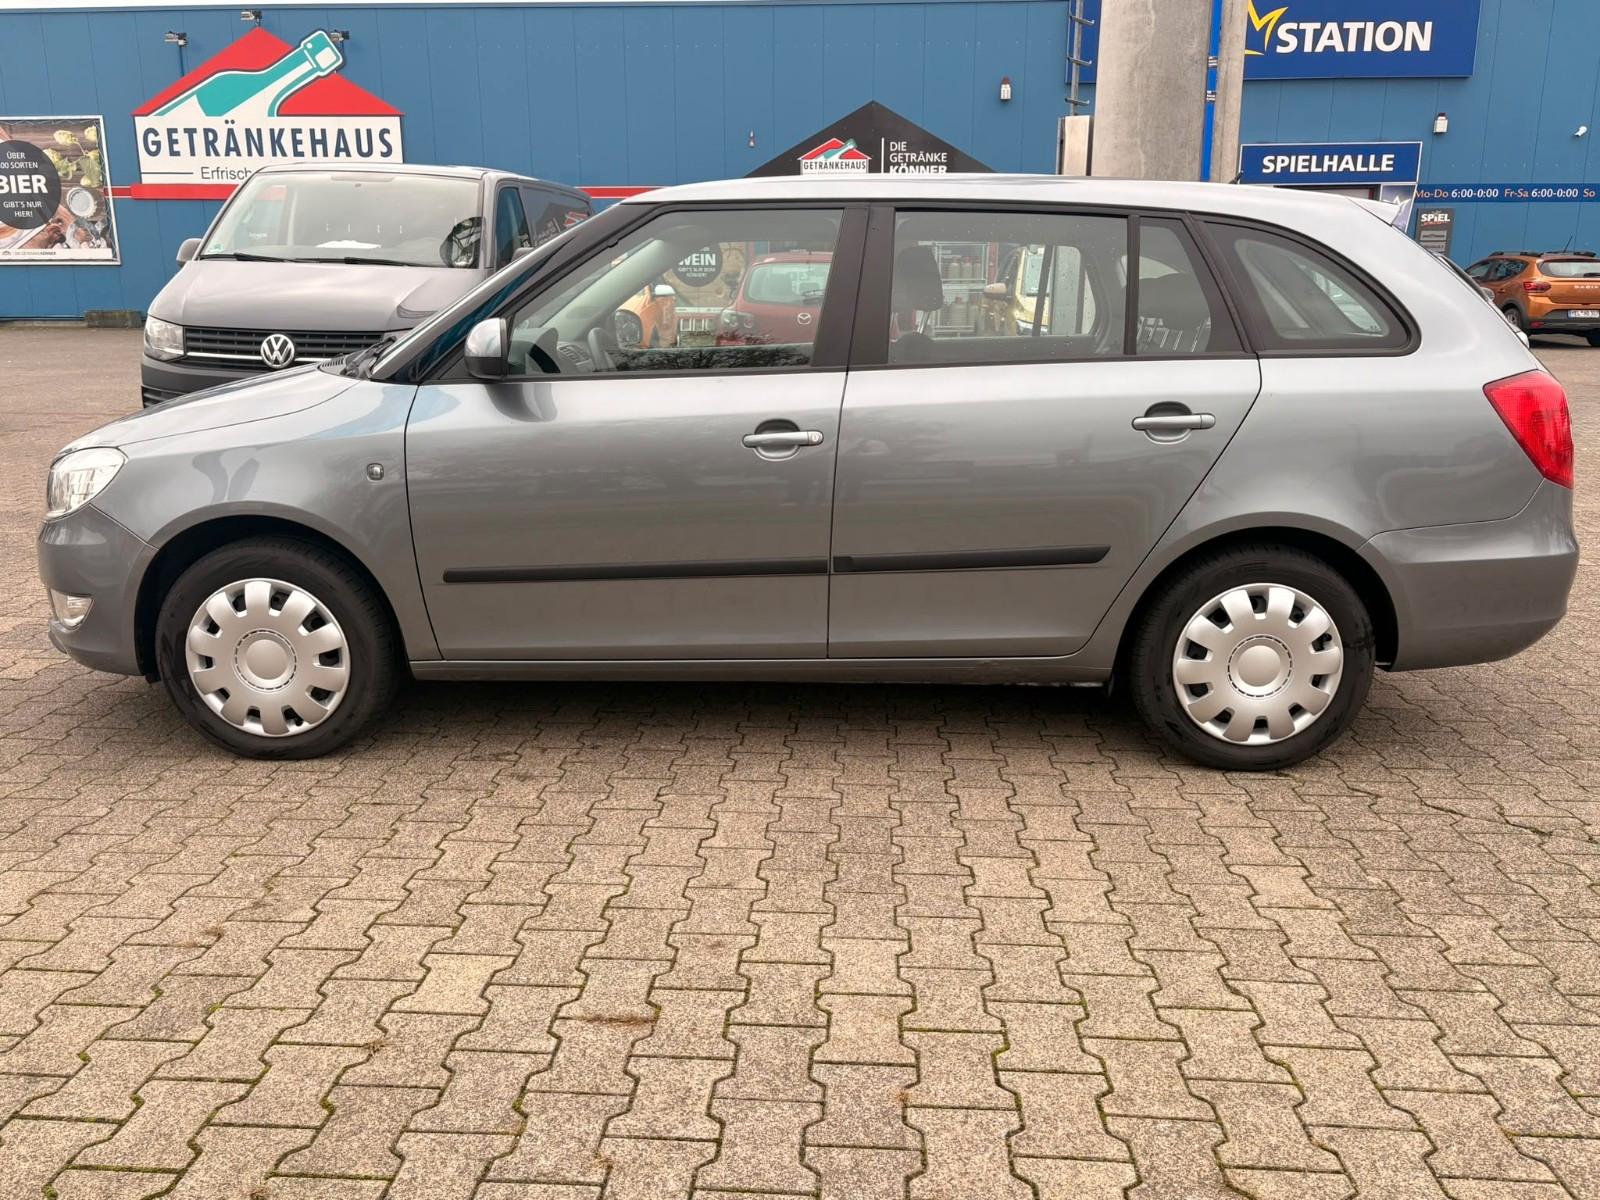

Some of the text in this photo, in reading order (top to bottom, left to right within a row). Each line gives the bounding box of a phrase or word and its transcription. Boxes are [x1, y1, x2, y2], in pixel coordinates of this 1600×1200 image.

[1276, 21, 1433, 54] STATION
[142, 119, 393, 158] GETRÄNKEHAUS
[889, 141, 907, 151] DIE
[6, 151, 26, 160] ÜBER
[889, 151, 948, 163] GETRÄNKE
[10, 161, 39, 169] SORTEN
[1261, 153, 1395, 174] SPIELHALLE
[1415, 188, 1596, 198] Mo-Do 6:00-0:00 Fr-Sa 6:00-0:00 So
[26, 200, 42, 208] NUR
